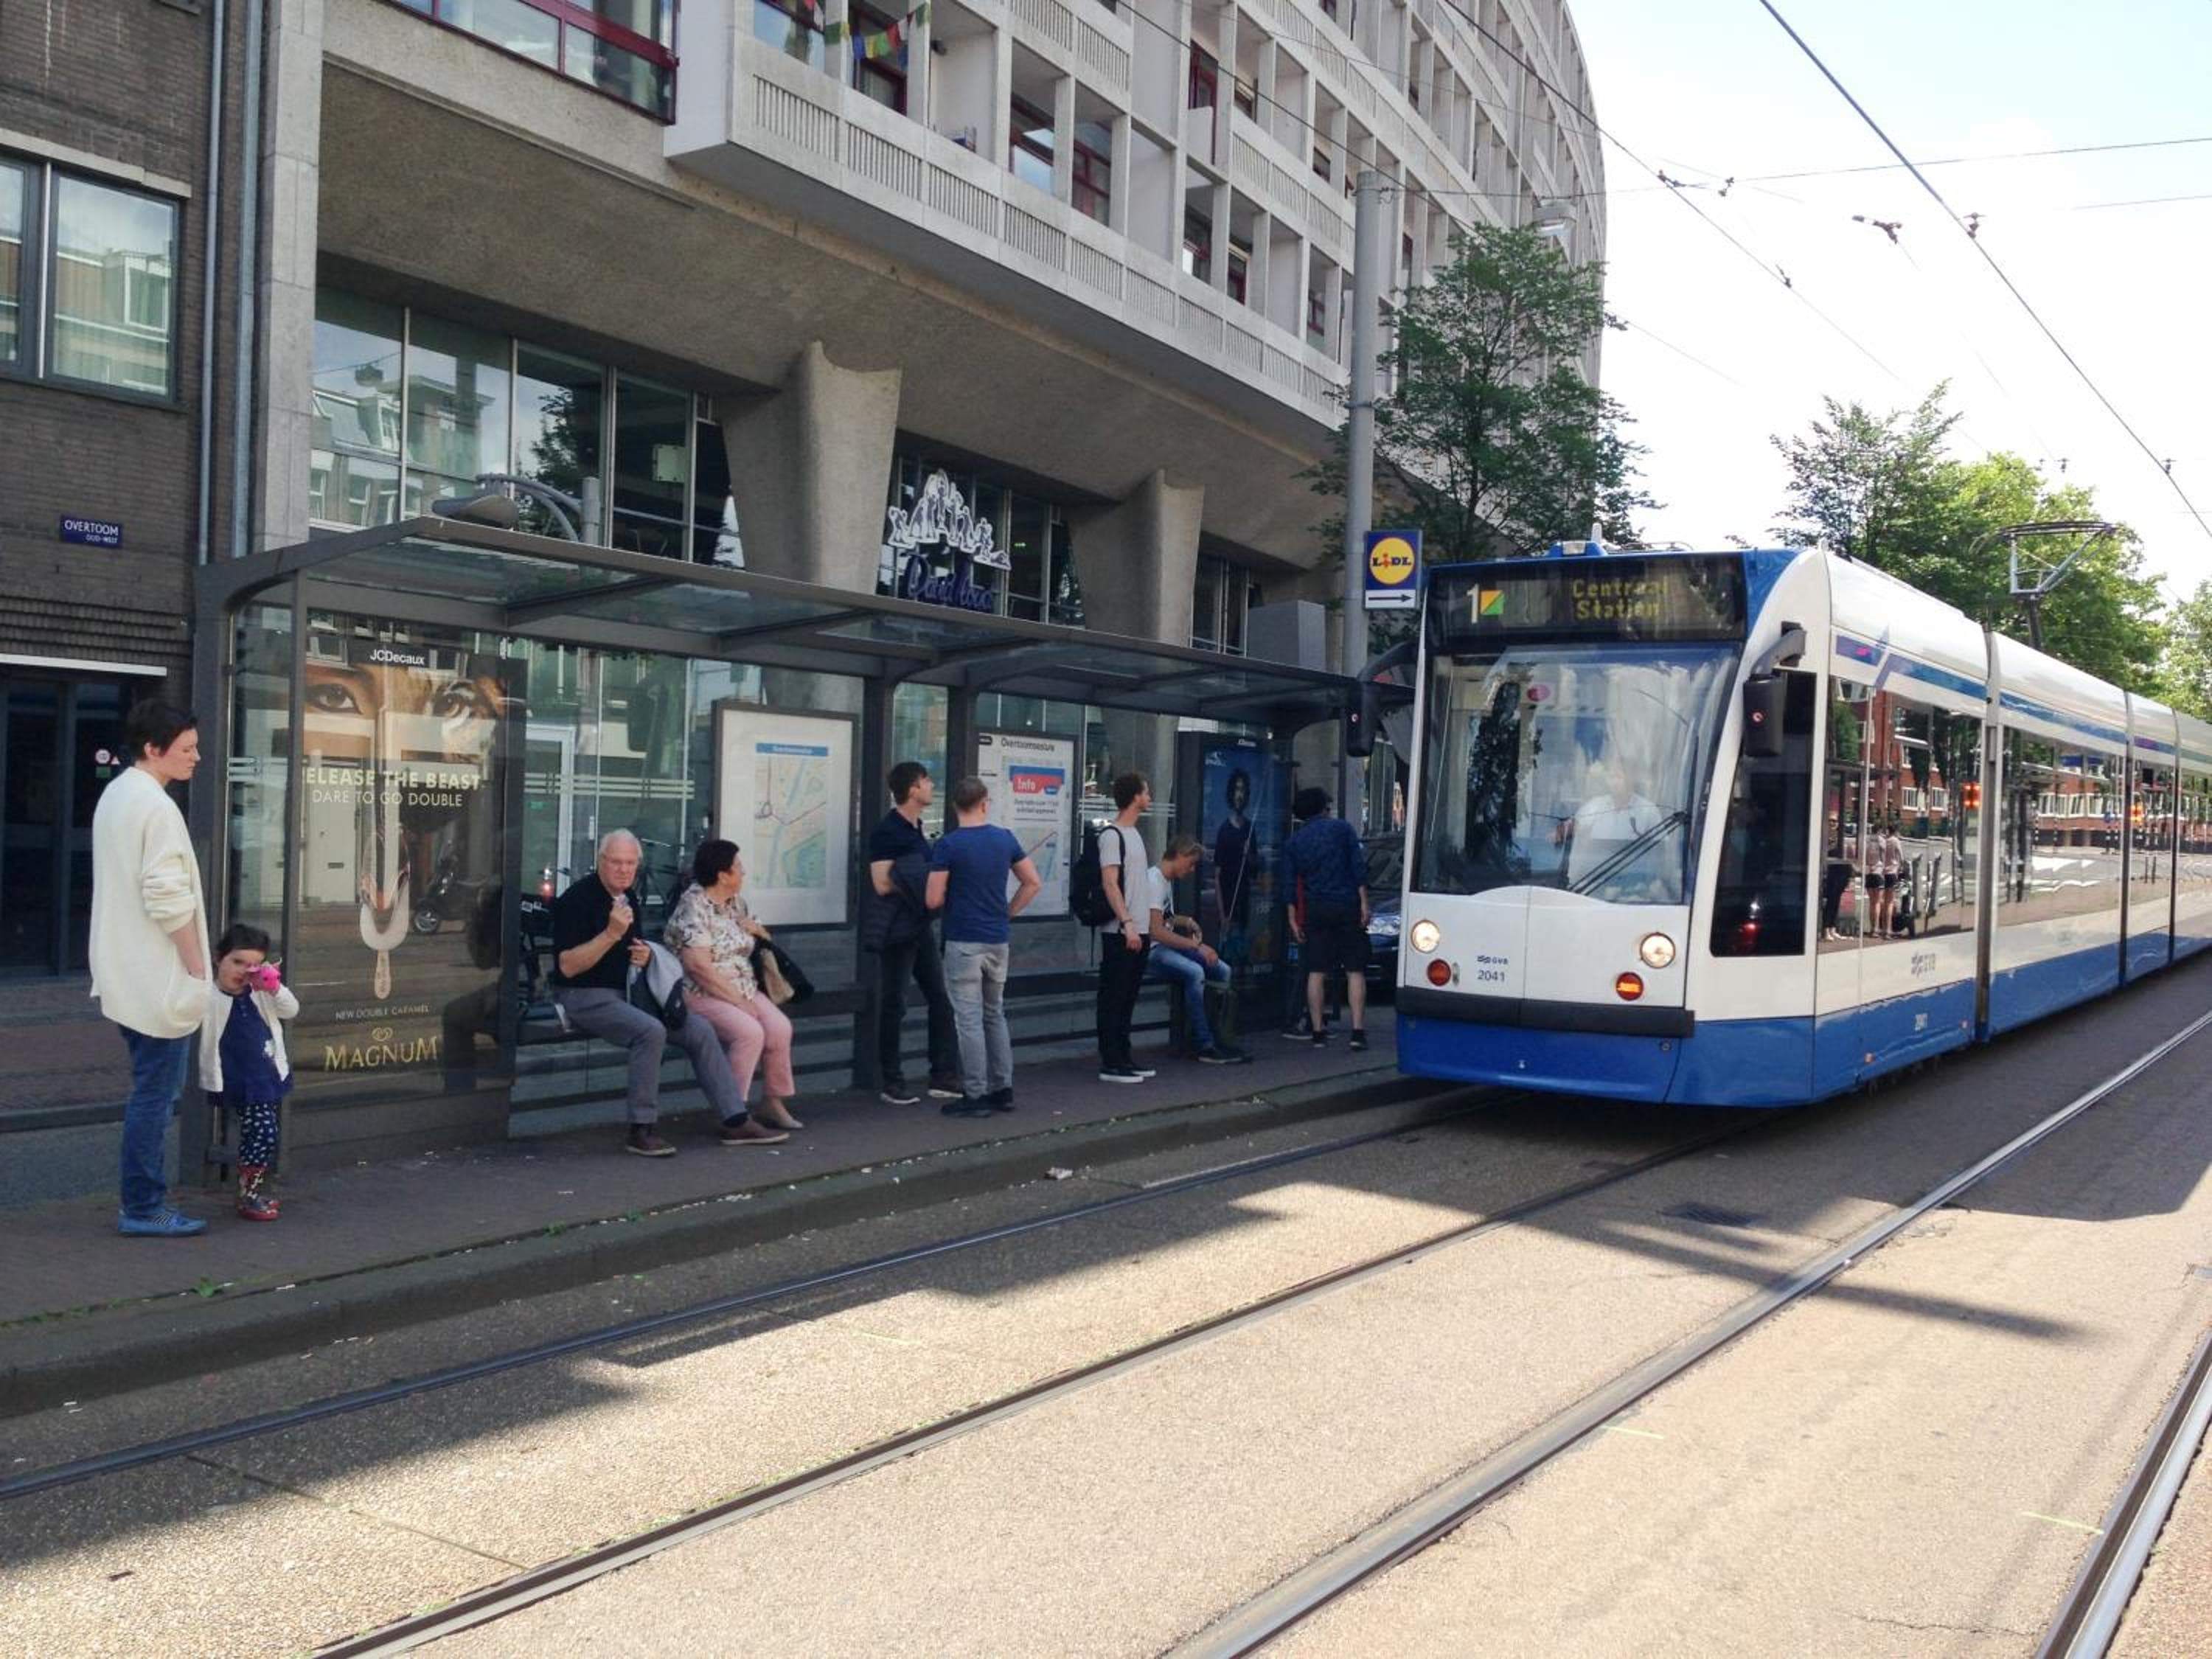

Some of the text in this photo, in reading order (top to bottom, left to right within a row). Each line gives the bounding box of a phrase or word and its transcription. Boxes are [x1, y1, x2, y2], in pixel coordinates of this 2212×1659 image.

[65, 520, 118, 536] OVERTOOM
[1467, 583, 1479, 624] 1
[370, 648, 425, 665] JCDecaux
[305, 768, 375, 786] ELEASE
[383, 771, 419, 788] THE
[1018, 778, 1036, 791] Info
[313, 789, 463, 807] DARE TO GO DOUBLE
[1477, 970, 1505, 982] 2041
[335, 1011, 354, 1020] NEW
[324, 1036, 438, 1072] MAGNUM
